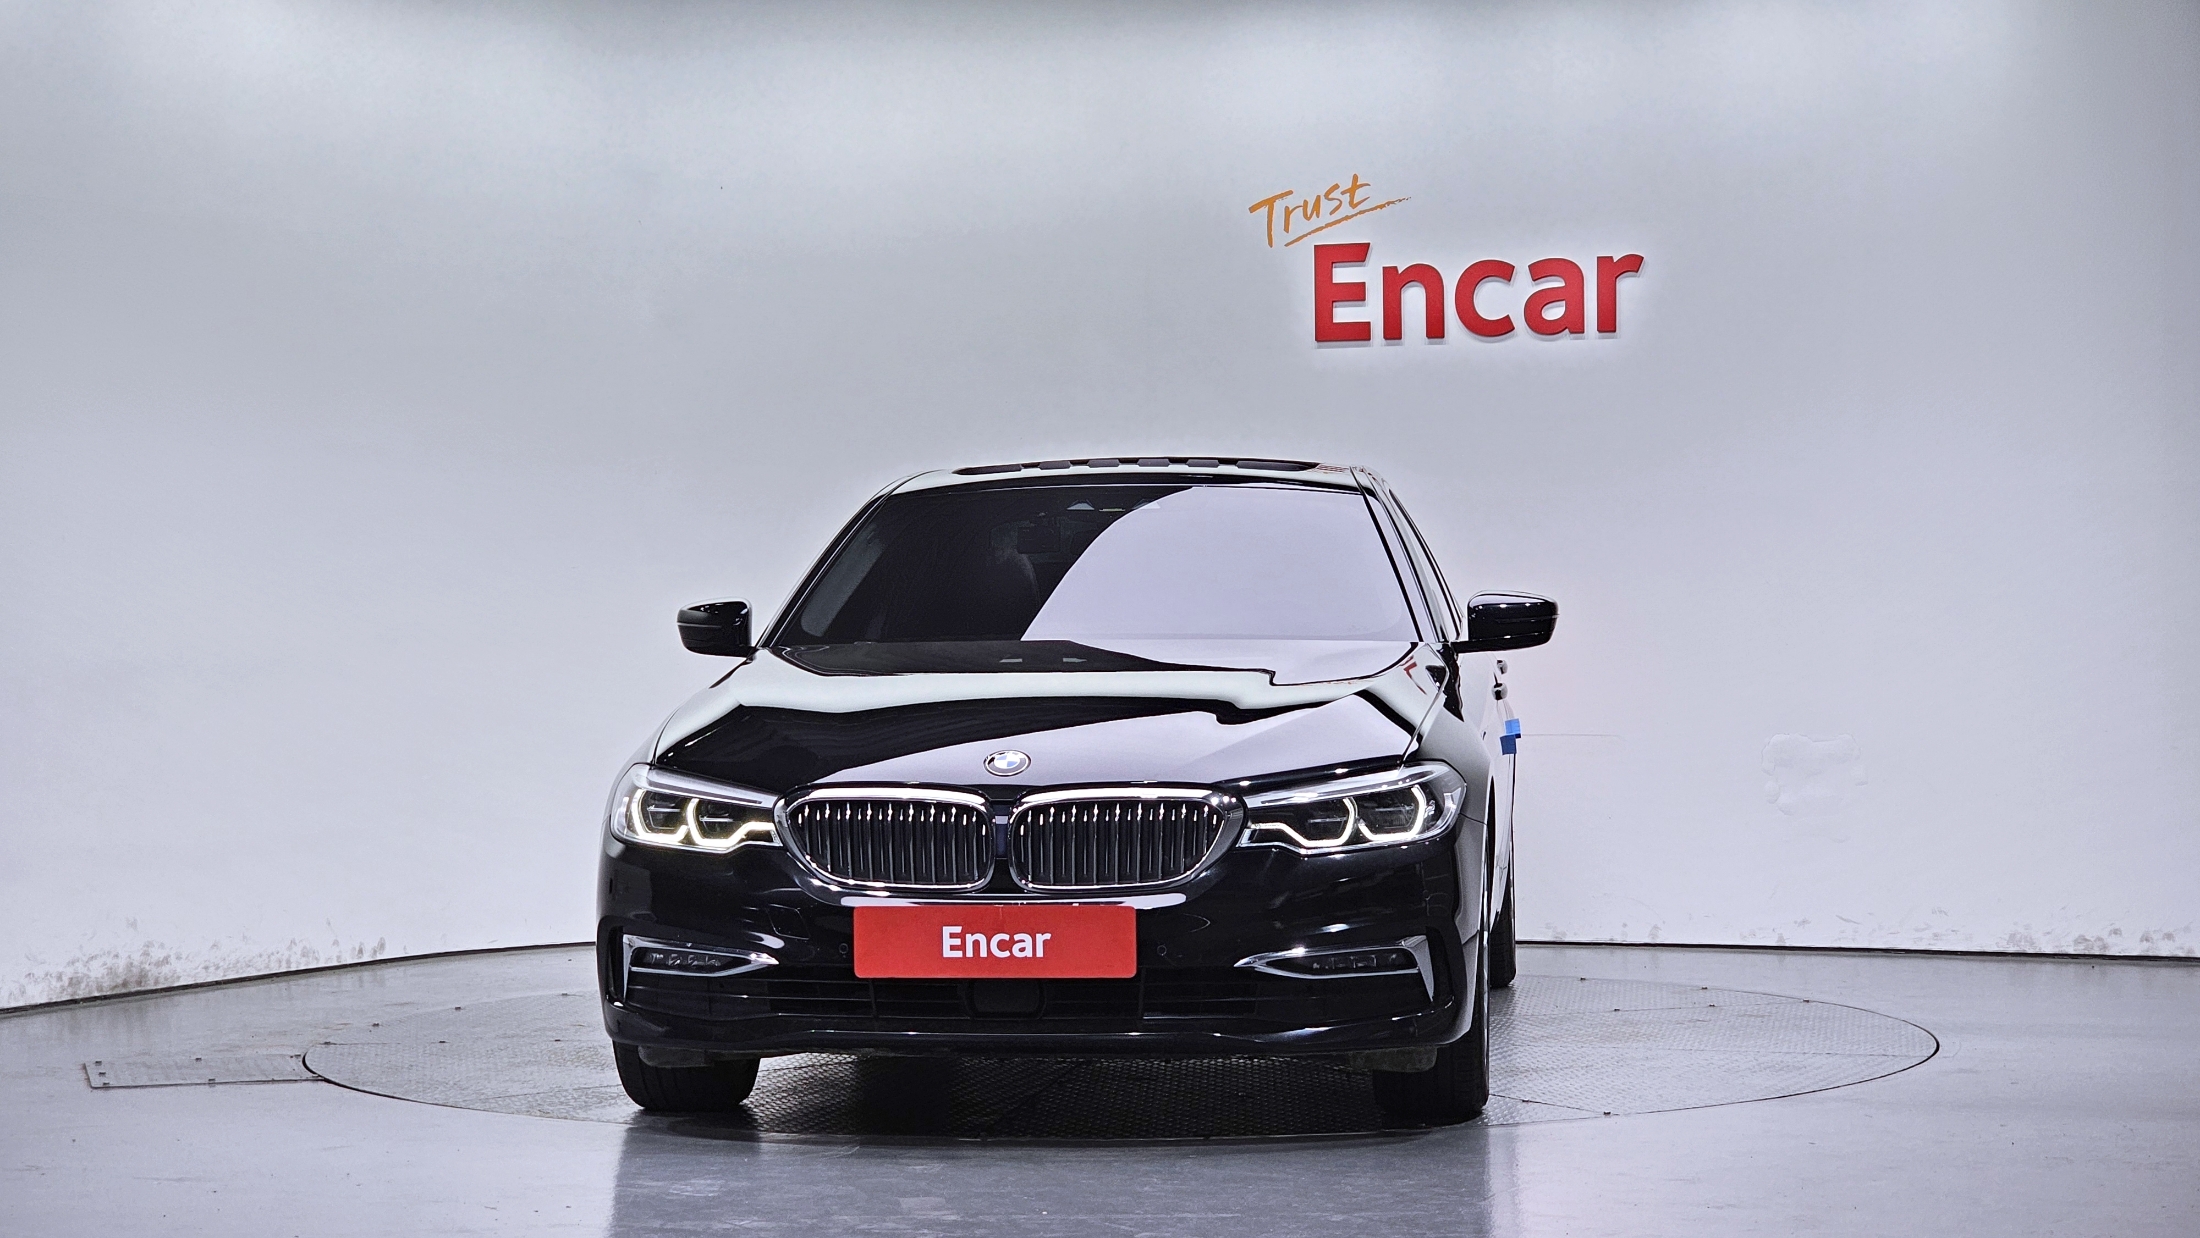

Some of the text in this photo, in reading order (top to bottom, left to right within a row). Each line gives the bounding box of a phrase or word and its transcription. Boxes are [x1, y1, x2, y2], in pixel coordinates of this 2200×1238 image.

[1249, 173, 1371, 248] Trust
[1314, 242, 1644, 342] Encar
[942, 925, 1052, 959] Encar
